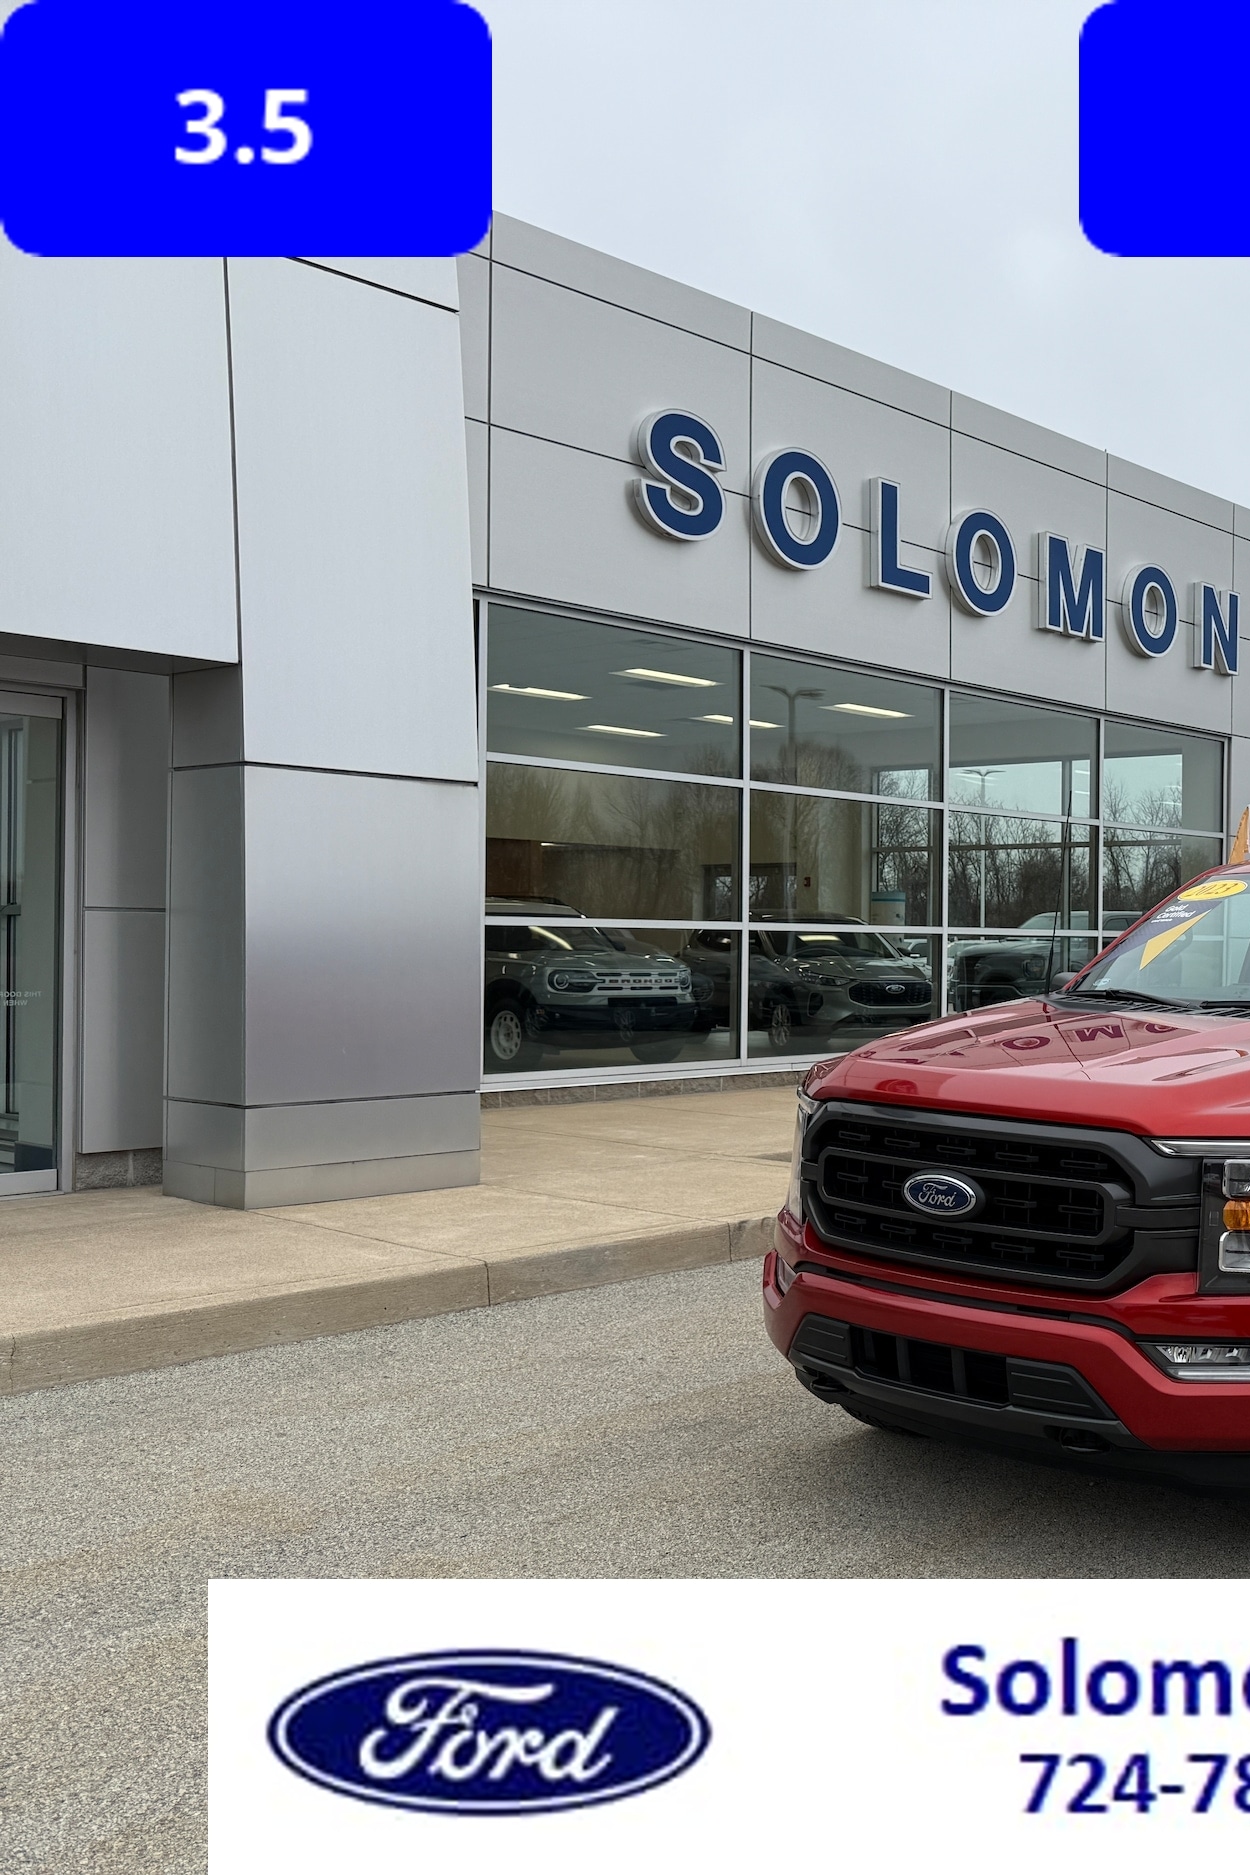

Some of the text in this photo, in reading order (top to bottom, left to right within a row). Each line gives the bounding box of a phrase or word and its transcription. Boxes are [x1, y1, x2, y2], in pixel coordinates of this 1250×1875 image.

[633, 407, 1241, 677] SOLOMON
[1157, 910, 1196, 918] Certified
[918, 1183, 957, 1207] Ford
